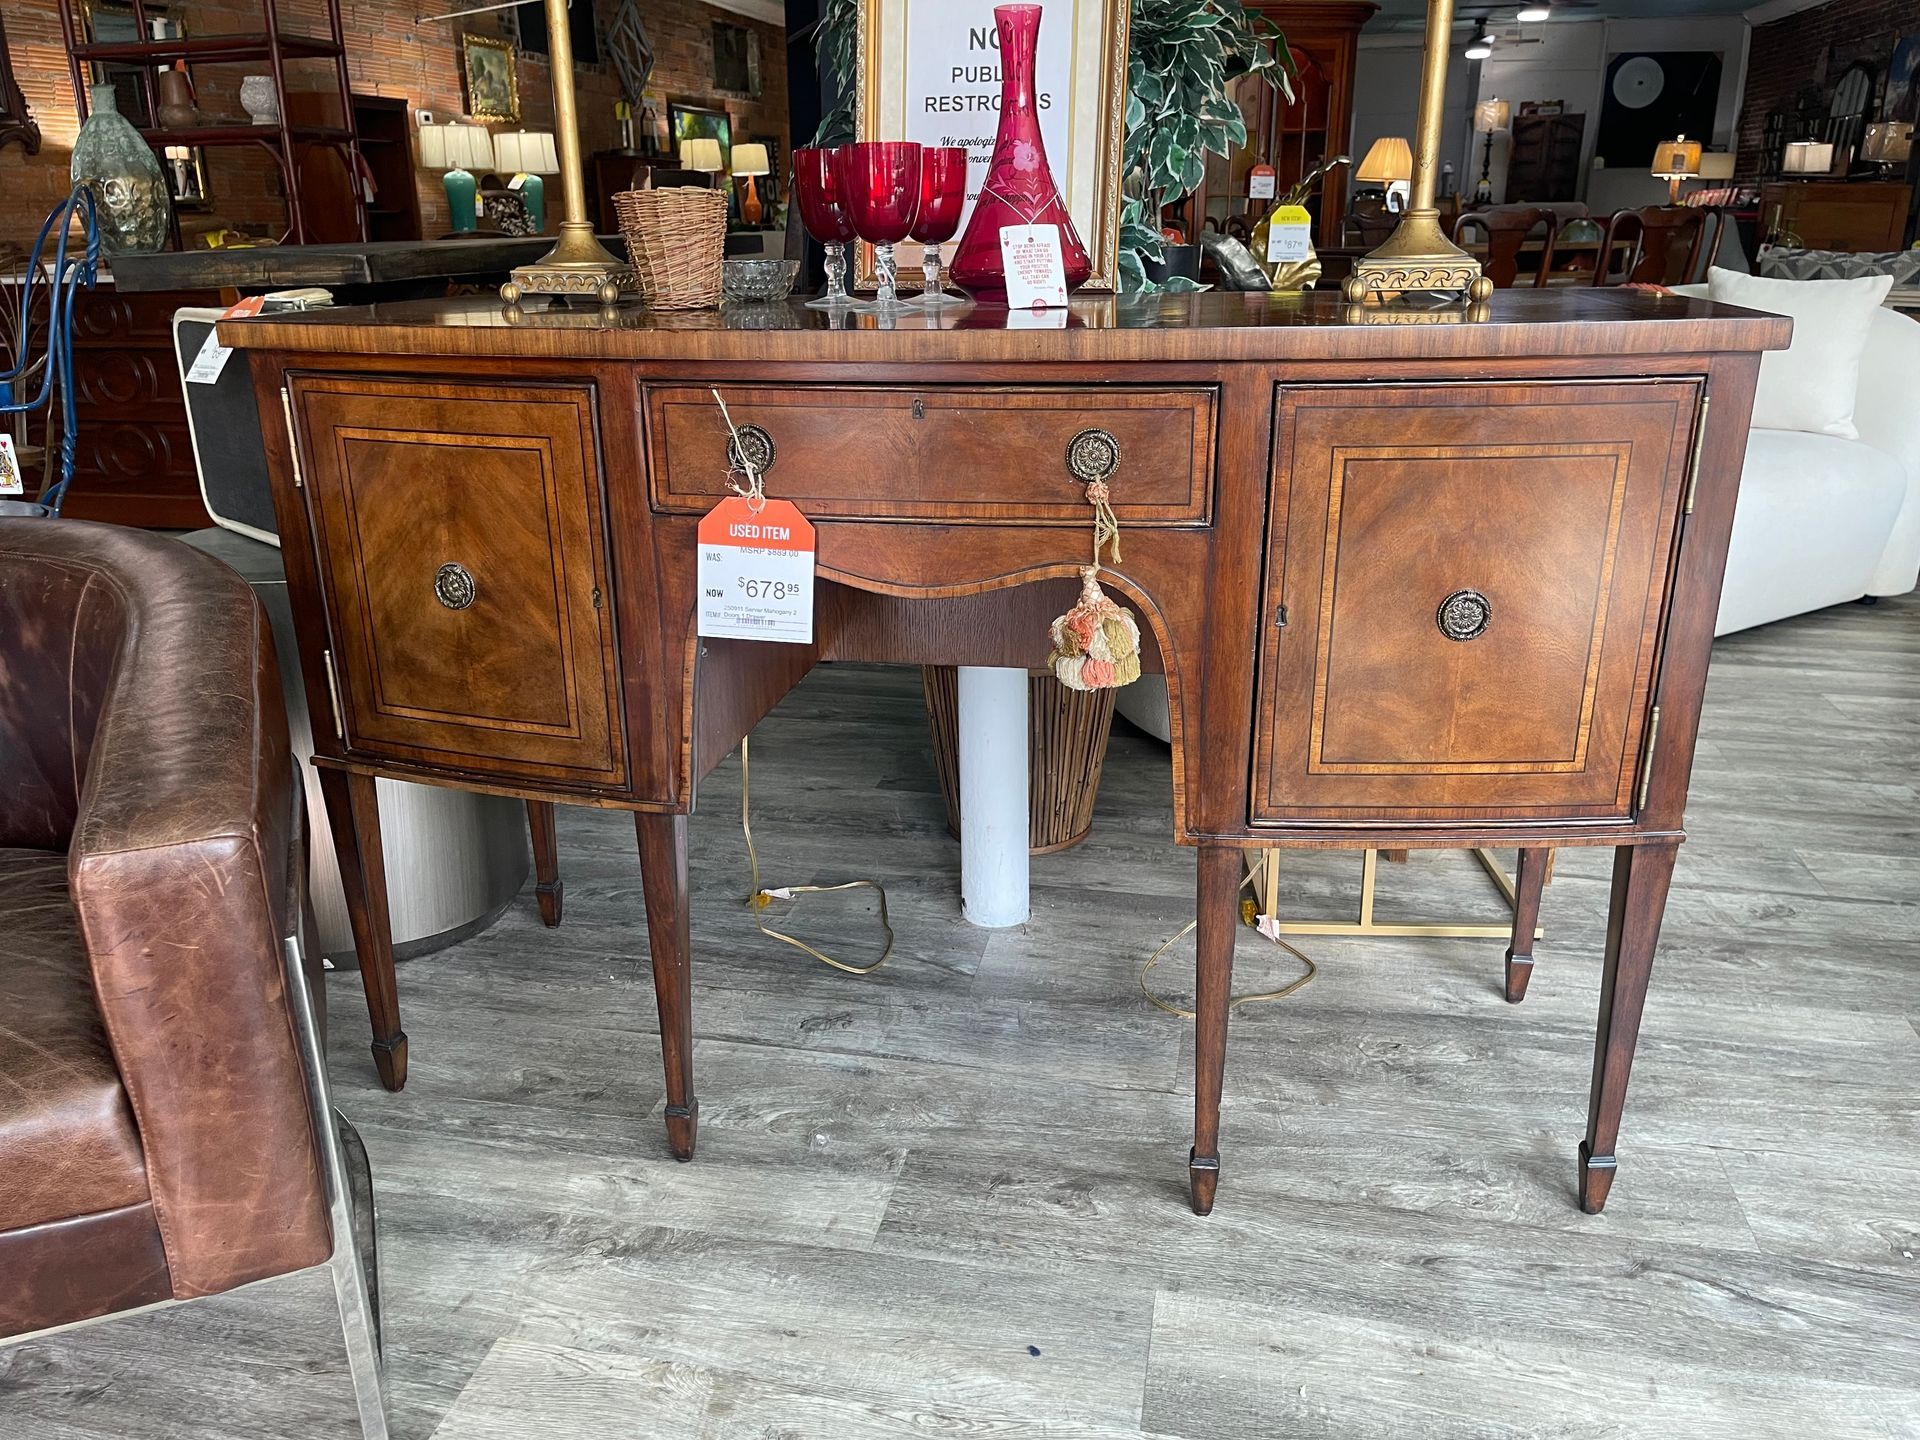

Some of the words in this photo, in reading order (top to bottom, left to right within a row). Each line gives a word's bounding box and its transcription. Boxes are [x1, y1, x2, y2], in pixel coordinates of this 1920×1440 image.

[925, 93, 1052, 112] RESTROS
[940, 136, 956, 147] We
[957, 135, 996, 149] apologiz
[729, 523, 760, 539] USED
[762, 526, 790, 540] ITEM
[706, 588, 724, 598] NOW
[764, 608, 792, 616] Mahogany
